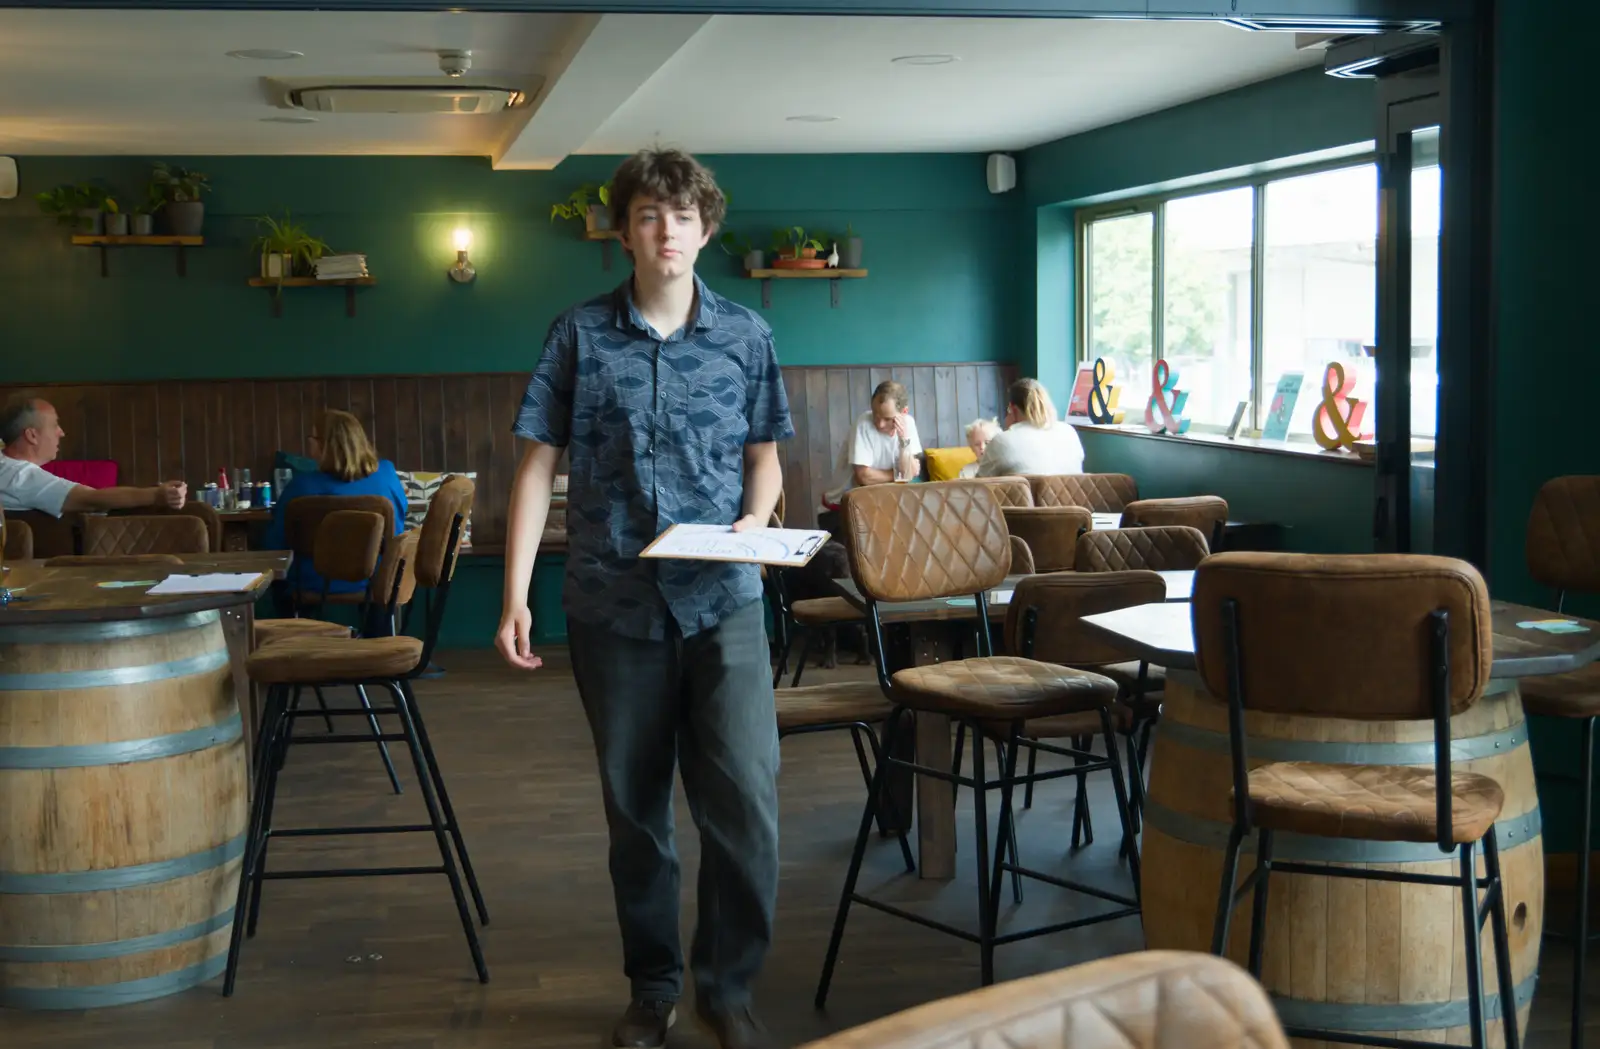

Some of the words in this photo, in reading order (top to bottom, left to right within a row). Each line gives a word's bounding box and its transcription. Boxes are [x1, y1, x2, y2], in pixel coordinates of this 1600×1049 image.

[1088, 358, 1119, 424] &
[1145, 359, 1186, 433] &
[1312, 362, 1369, 452] &
